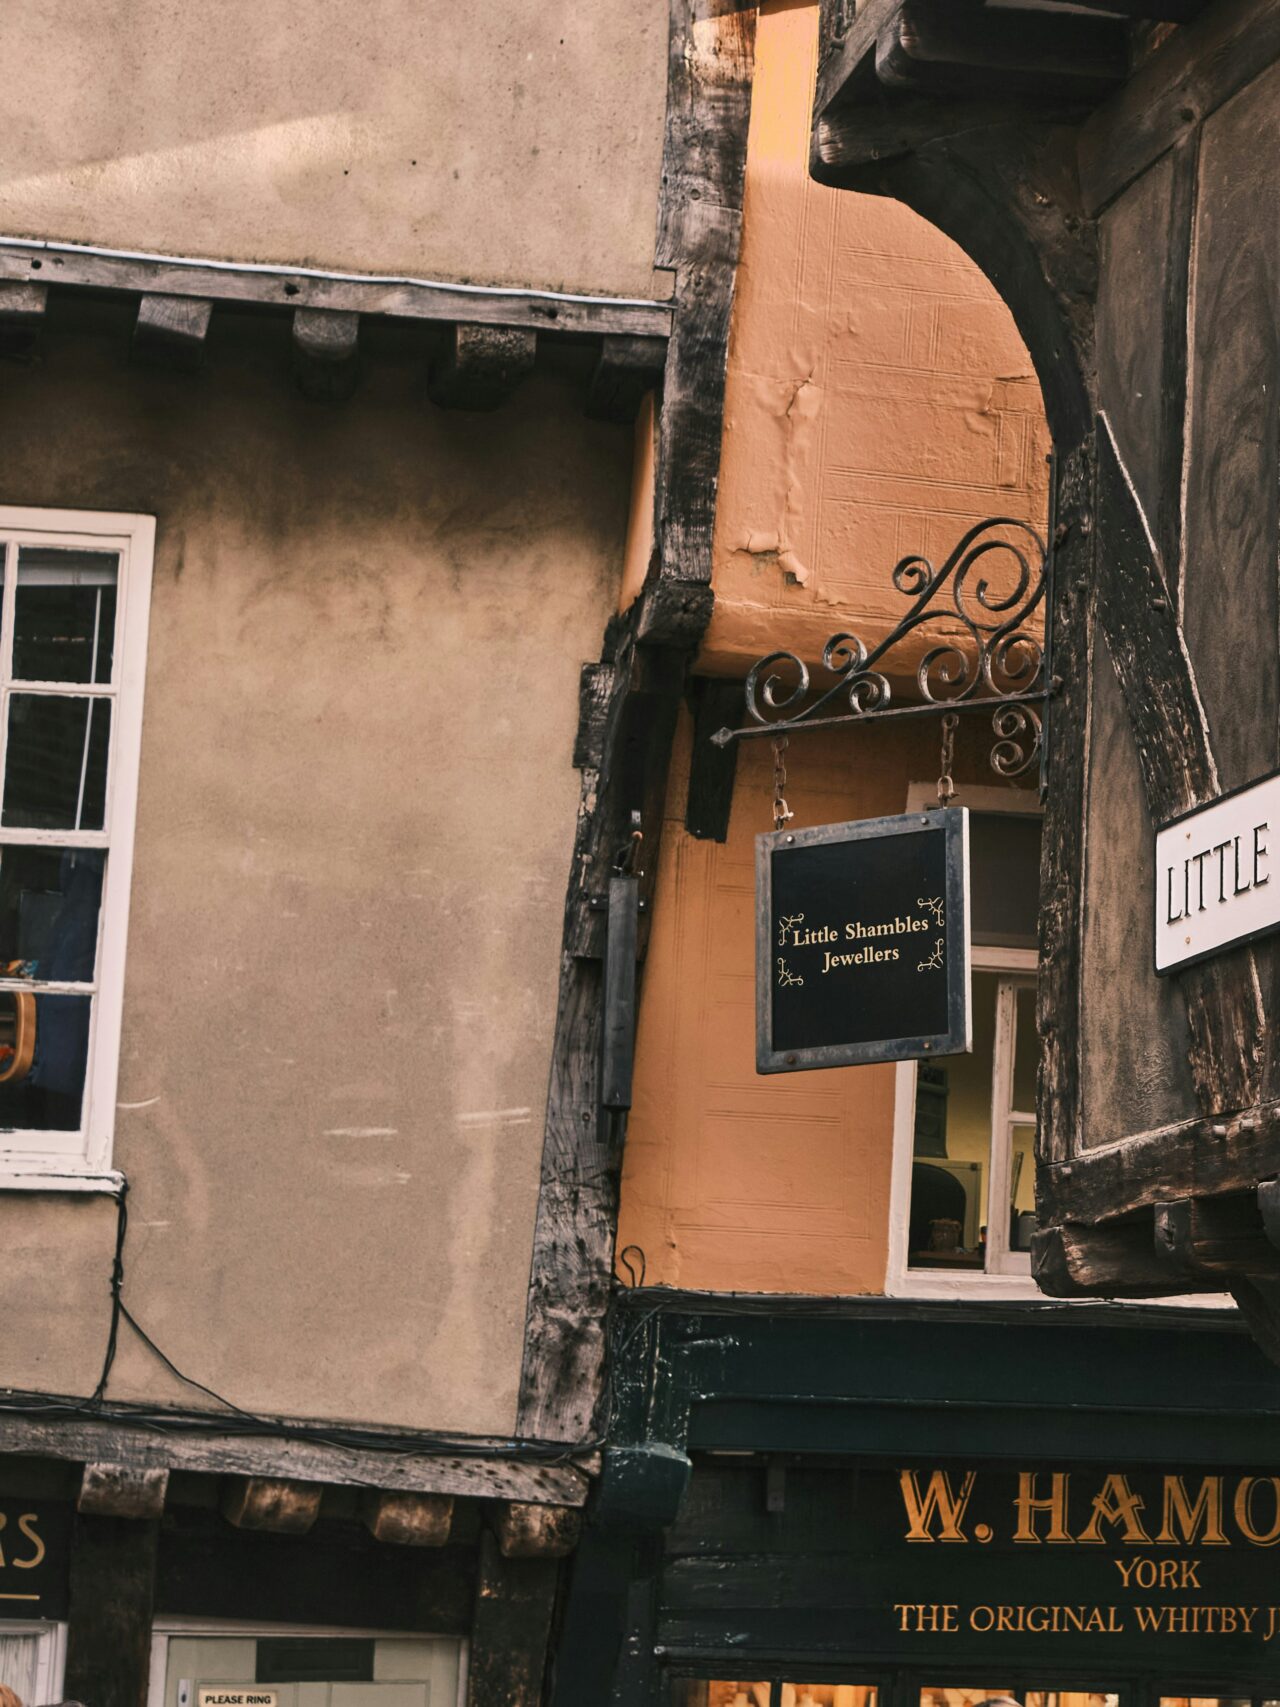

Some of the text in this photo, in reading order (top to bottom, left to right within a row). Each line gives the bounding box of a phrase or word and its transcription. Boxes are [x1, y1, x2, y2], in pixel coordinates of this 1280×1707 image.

[1166, 822, 1270, 925] LITTLE
[792, 916, 929, 946] Little Shambles
[822, 946, 900, 973] Jewellers
[896, 1469, 994, 1543] W.
[0, 1512, 46, 1568] S
[1114, 1556, 1202, 1590] YORK
[894, 1605, 959, 1632] THE
[970, 1606, 1124, 1632] ORIGINAL
[1134, 1607, 1258, 1633] WHITBY
[205, 1695, 272, 1704] PLEASE RING
